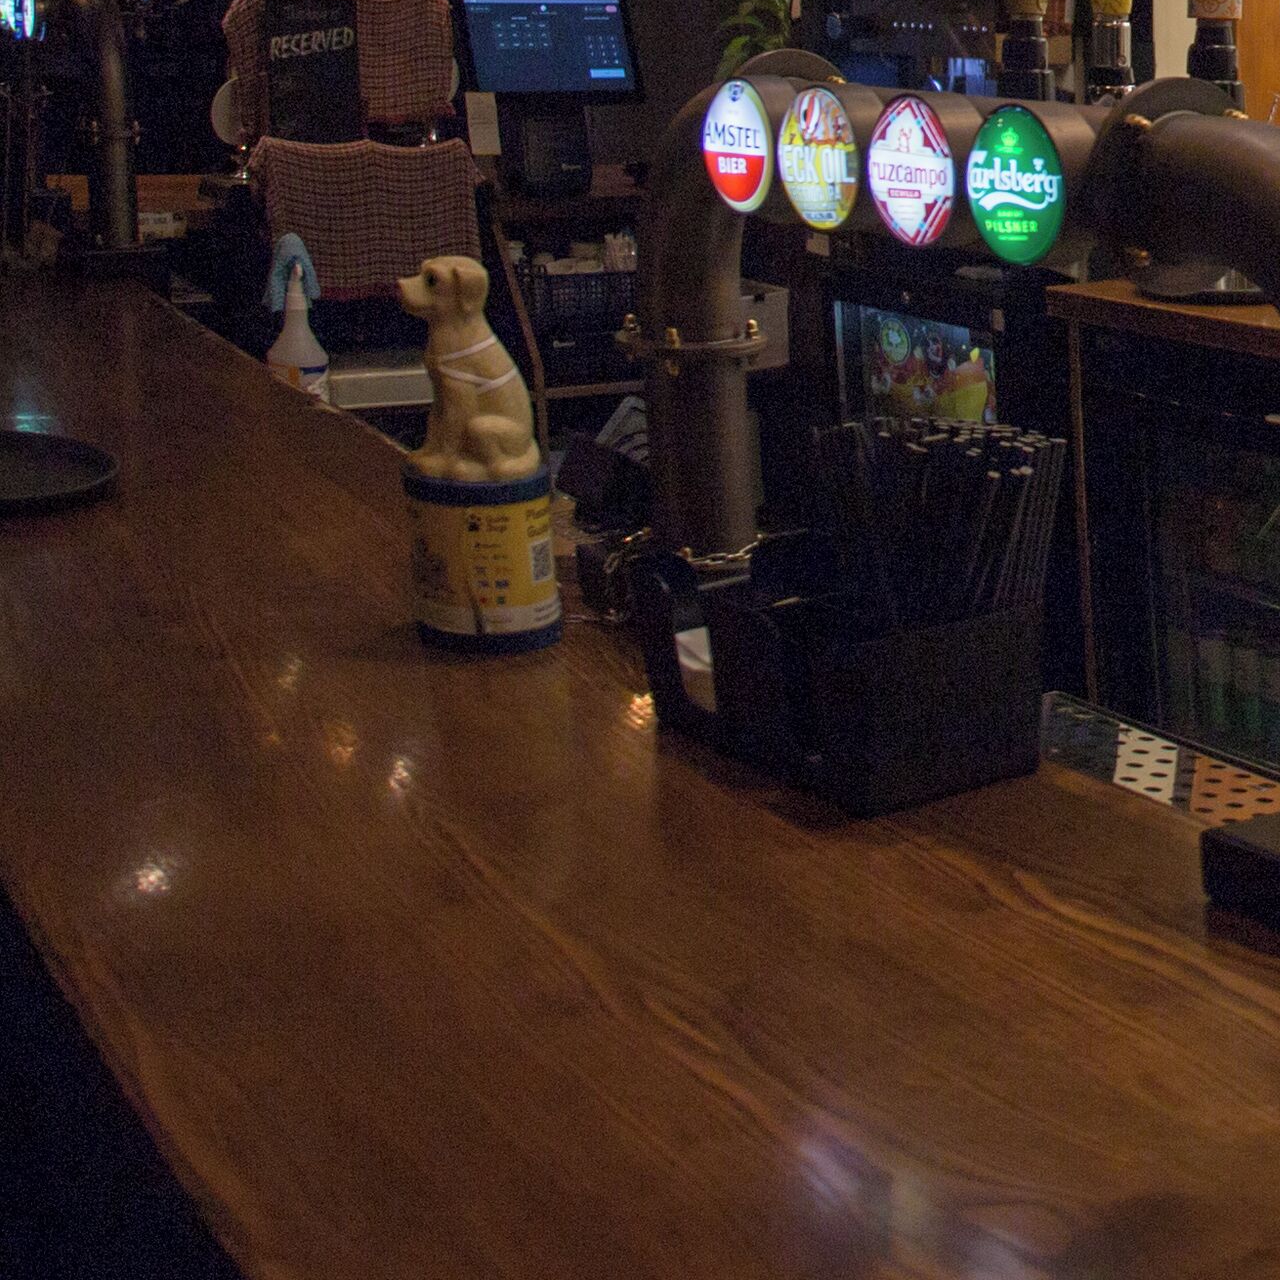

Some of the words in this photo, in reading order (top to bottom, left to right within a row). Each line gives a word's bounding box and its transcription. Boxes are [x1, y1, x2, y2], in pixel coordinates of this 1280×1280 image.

[270, 26, 355, 62] RESERVED
[704, 125, 762, 149] AMSTEL
[717, 156, 748, 175] BIER
[783, 145, 818, 184] ECK
[968, 149, 1064, 204] Carlsberg
[986, 218, 1038, 234] PILSNER
